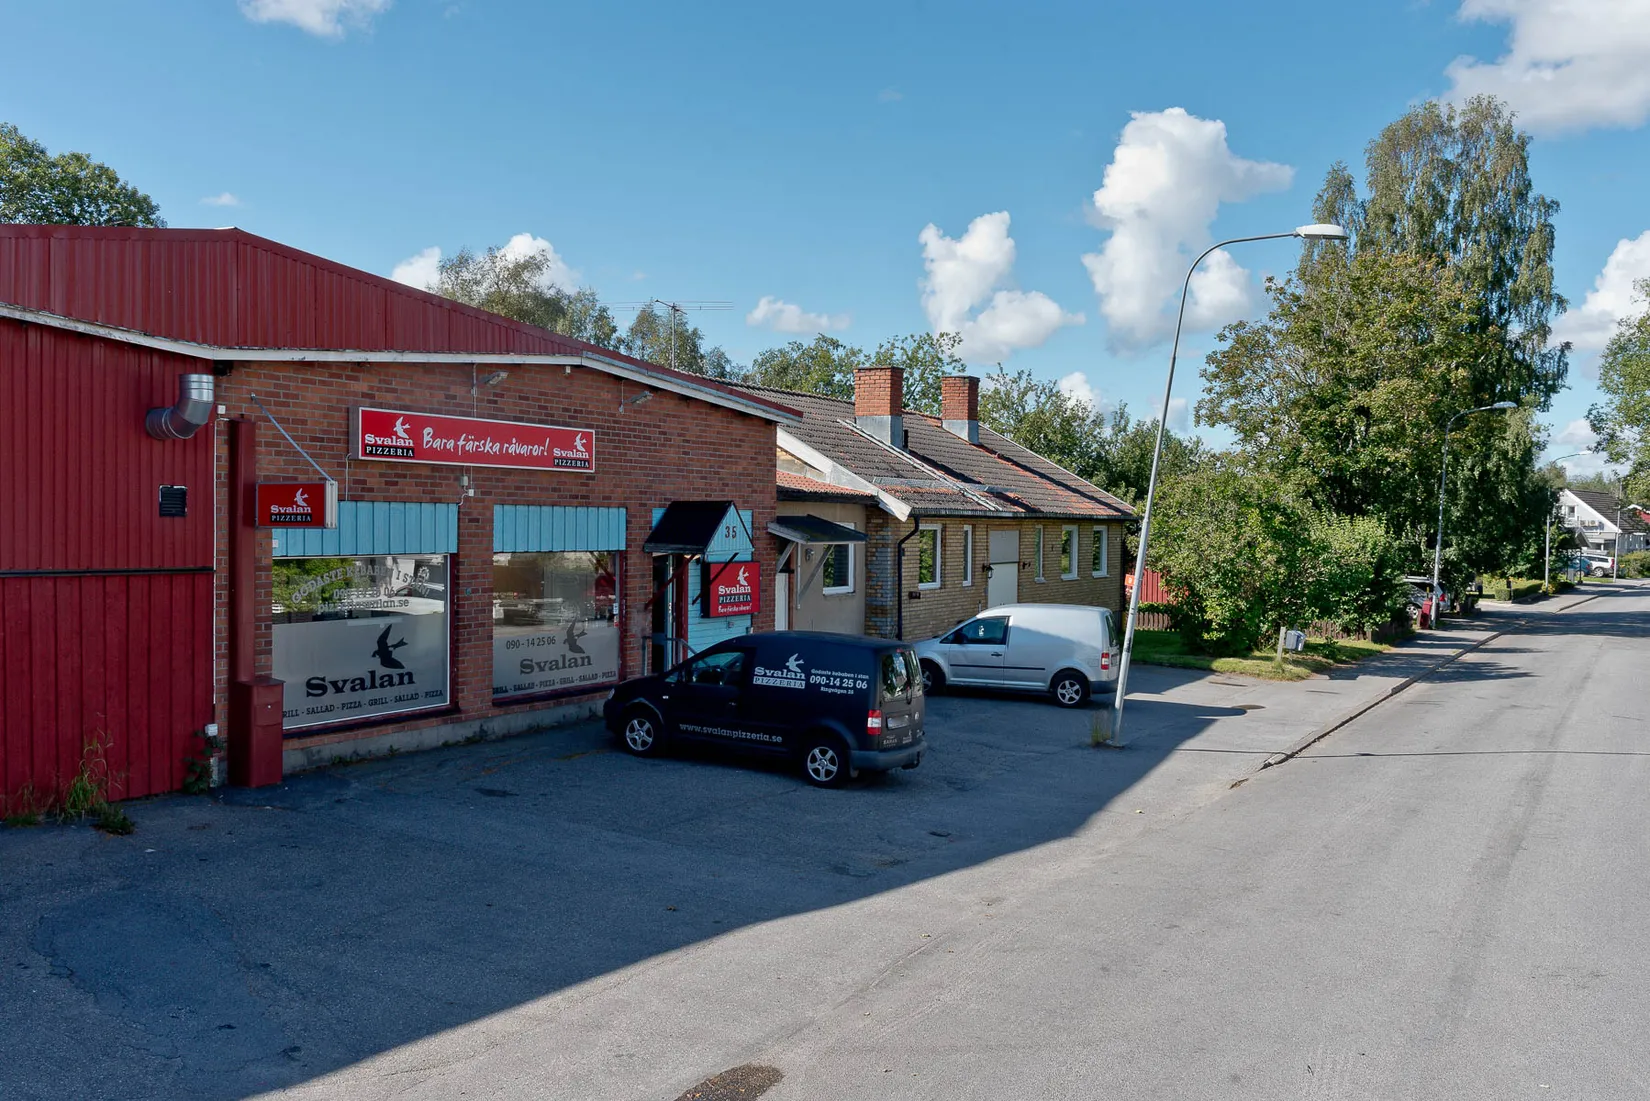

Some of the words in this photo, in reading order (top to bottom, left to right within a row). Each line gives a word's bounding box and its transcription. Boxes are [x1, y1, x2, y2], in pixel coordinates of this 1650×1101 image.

[365, 433, 414, 447] Svalan
[422, 427, 453, 451] Bara
[453, 434, 500, 456] färska
[503, 437, 549, 456] råvaror!
[366, 446, 414, 457] PIZZERIA
[553, 448, 589, 459] Svalan
[554, 458, 589, 468] PIZZERIA
[270, 504, 312, 514] Svalan
[725, 525, 737, 539] 35
[719, 584, 751, 594] Svalan
[719, 594, 751, 604] PIZZERIA
[506, 640, 520, 650] 090
[527, 638, 536, 648] 14
[536, 636, 546, 647] 25
[546, 635, 557, 646] 06
[520, 653, 593, 676] Svalan
[540, 679, 556, 688] PIZZA
[602, 670, 617, 678] PIZZA
[754, 666, 806, 679] Svalan
[306, 670, 416, 697] Svalan
[754, 677, 805, 688] PIZZERIA
[809, 675, 840, 686] 090-14
[842, 679, 854, 688] 25
[856, 680, 868, 689] 06
[283, 710, 300, 719] RILL
[306, 705, 335, 715] SALLAD
[341, 700, 362, 710] PIZZA
[368, 697, 389, 707] GRILL
[394, 692, 419, 703] SALLAD
[424, 689, 444, 698] PIZZA
[679, 723, 783, 743] www.svalanpizzeria.se
